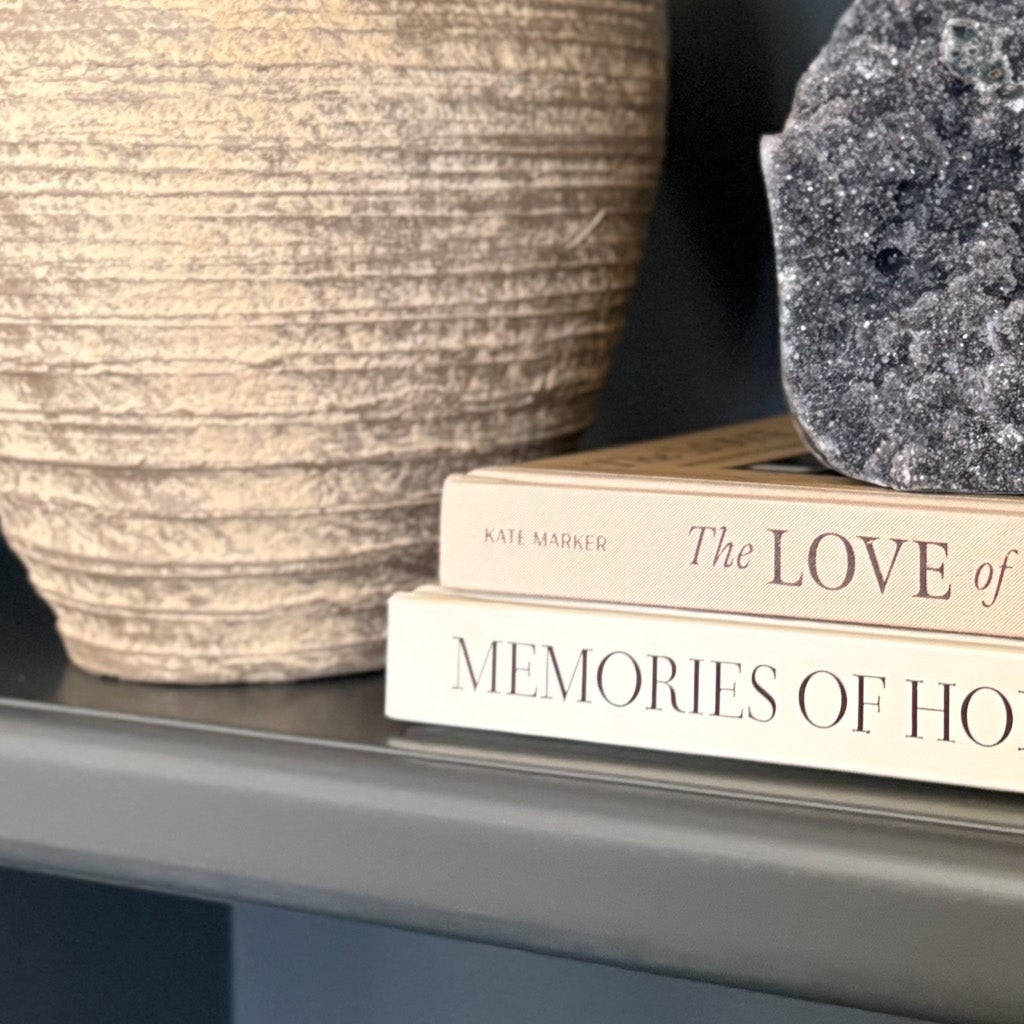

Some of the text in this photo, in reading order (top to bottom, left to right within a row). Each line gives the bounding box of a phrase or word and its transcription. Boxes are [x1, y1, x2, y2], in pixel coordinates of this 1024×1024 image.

[483, 527, 608, 553] KATE MARKER
[688, 525, 754, 570] The
[767, 528, 952, 600] LOVE
[974, 549, 1019, 608] of
[451, 636, 778, 724] MEMORIES
[798, 669, 887, 735] OF
